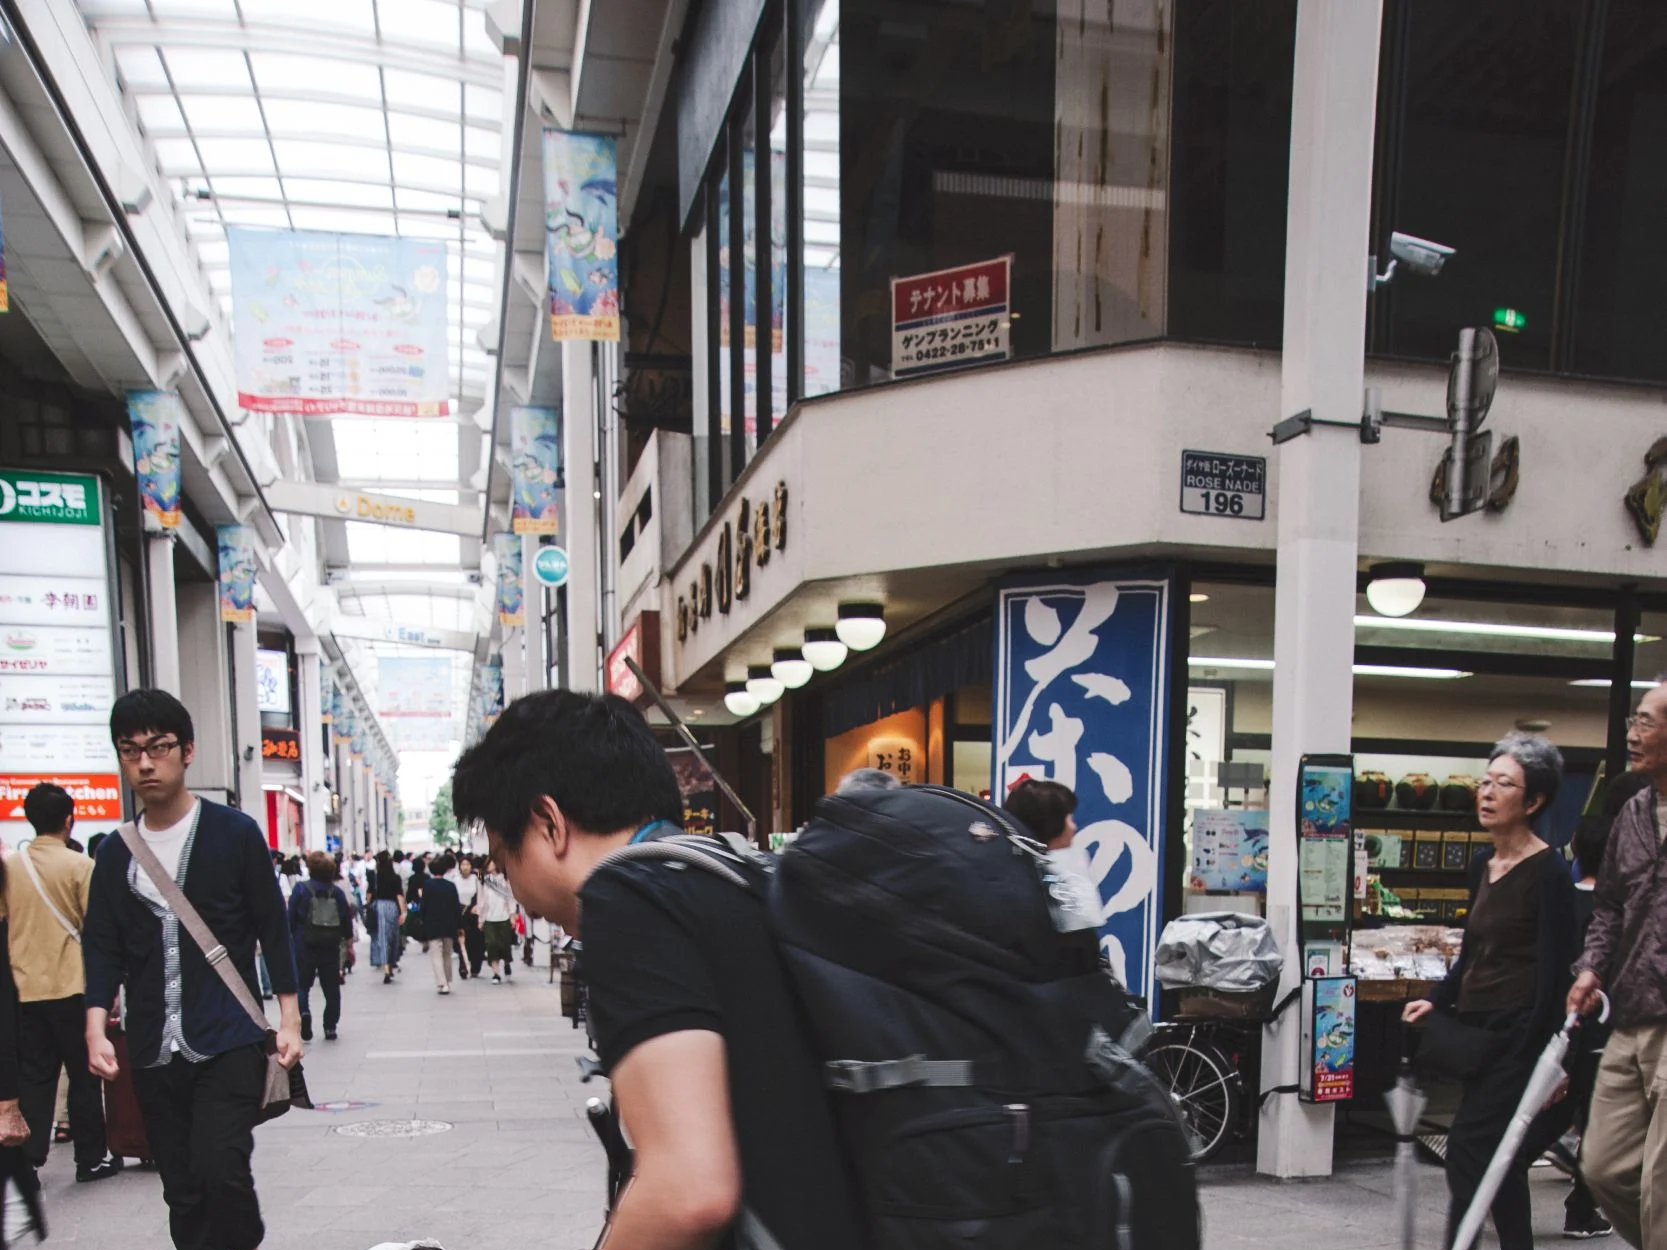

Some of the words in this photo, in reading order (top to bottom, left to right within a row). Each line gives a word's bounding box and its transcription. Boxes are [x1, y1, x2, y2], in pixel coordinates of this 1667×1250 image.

[910, 275, 990, 314] テナント募集
[902, 318, 998, 350] ゲンプランニング
[16, 480, 87, 509] コスモ
[1187, 475, 1221, 489] ROSE
[1225, 479, 1260, 492] NADE
[18, 506, 88, 518] KICHIJOJI
[356, 495, 415, 523] Dome
[1200, 491, 1244, 514] 196
